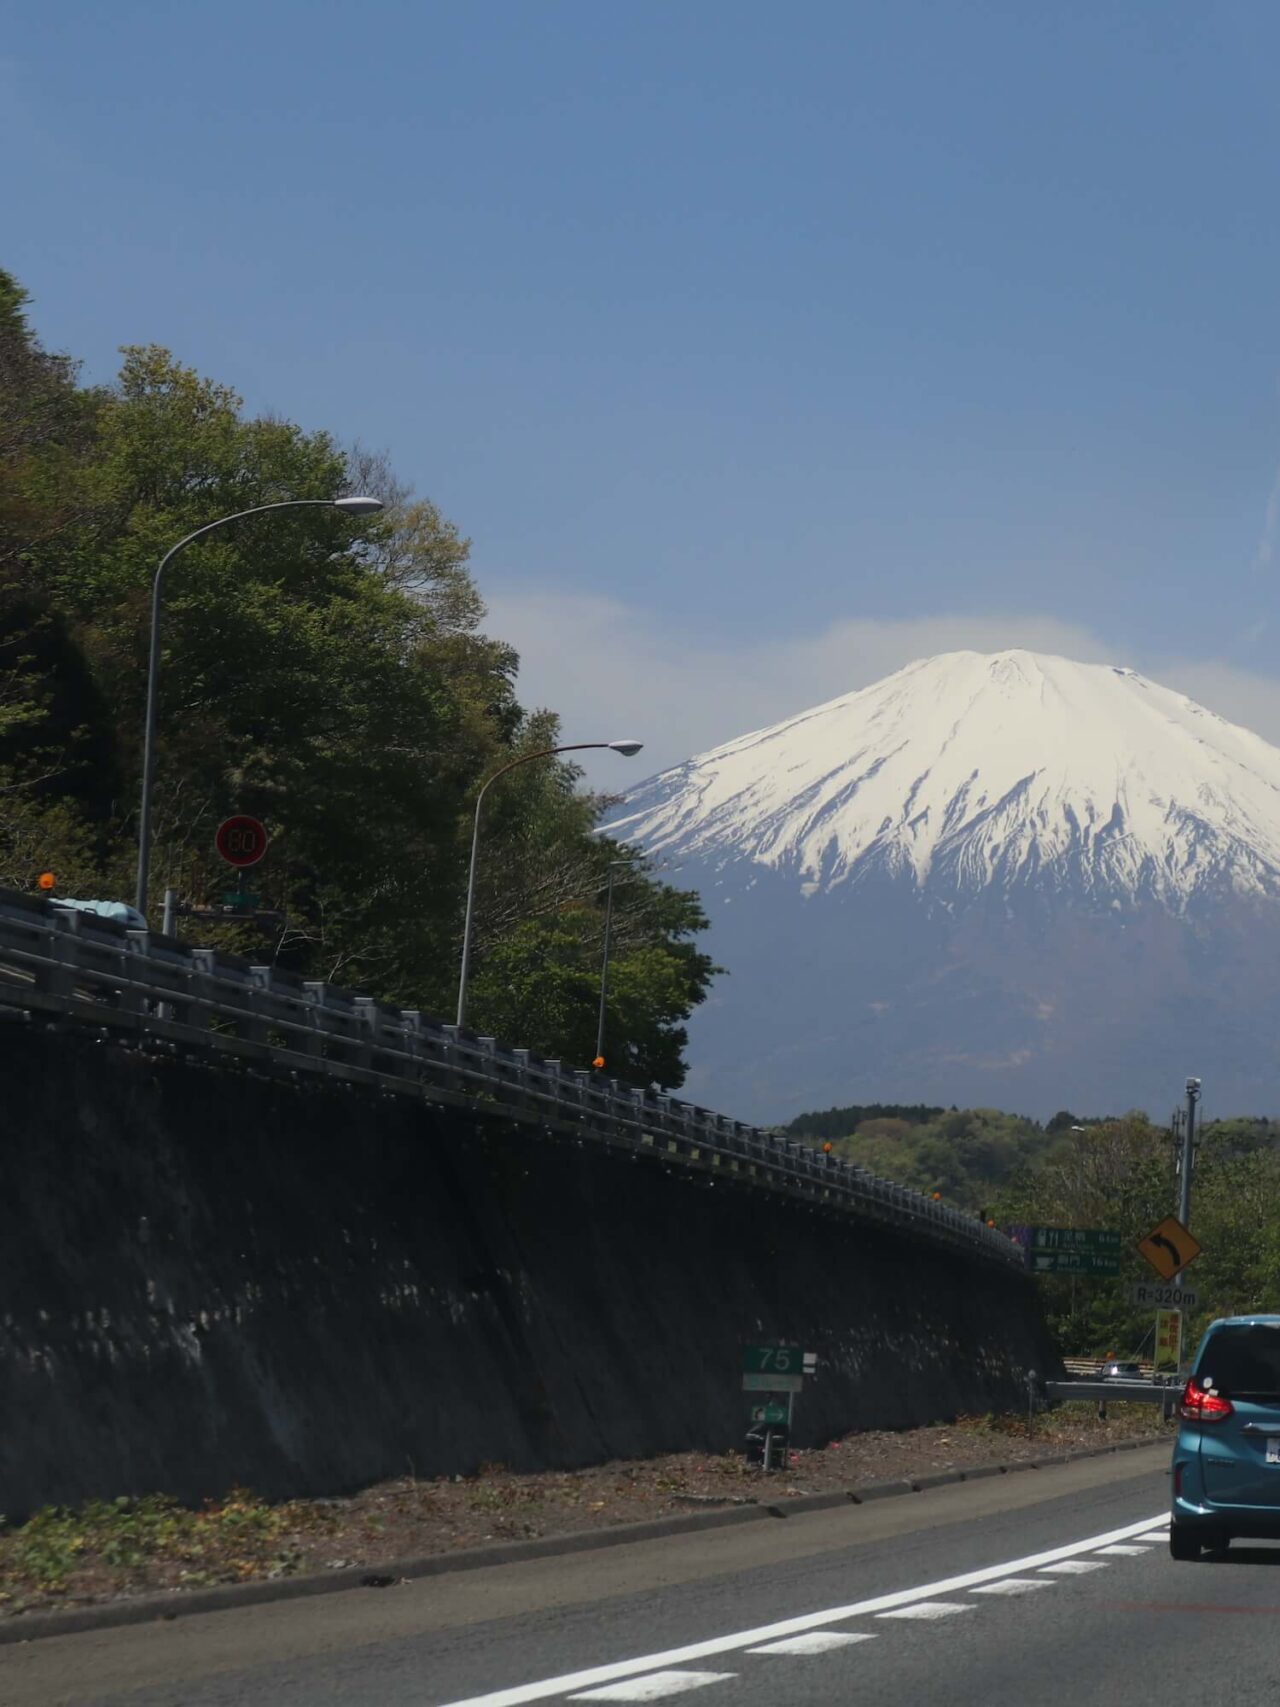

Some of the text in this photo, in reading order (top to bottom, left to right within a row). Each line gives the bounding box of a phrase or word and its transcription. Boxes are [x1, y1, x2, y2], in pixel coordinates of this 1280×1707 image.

[228, 829, 256, 852] 80
[1137, 1287, 1196, 1305] R=320m
[759, 1348, 790, 1370] 75
